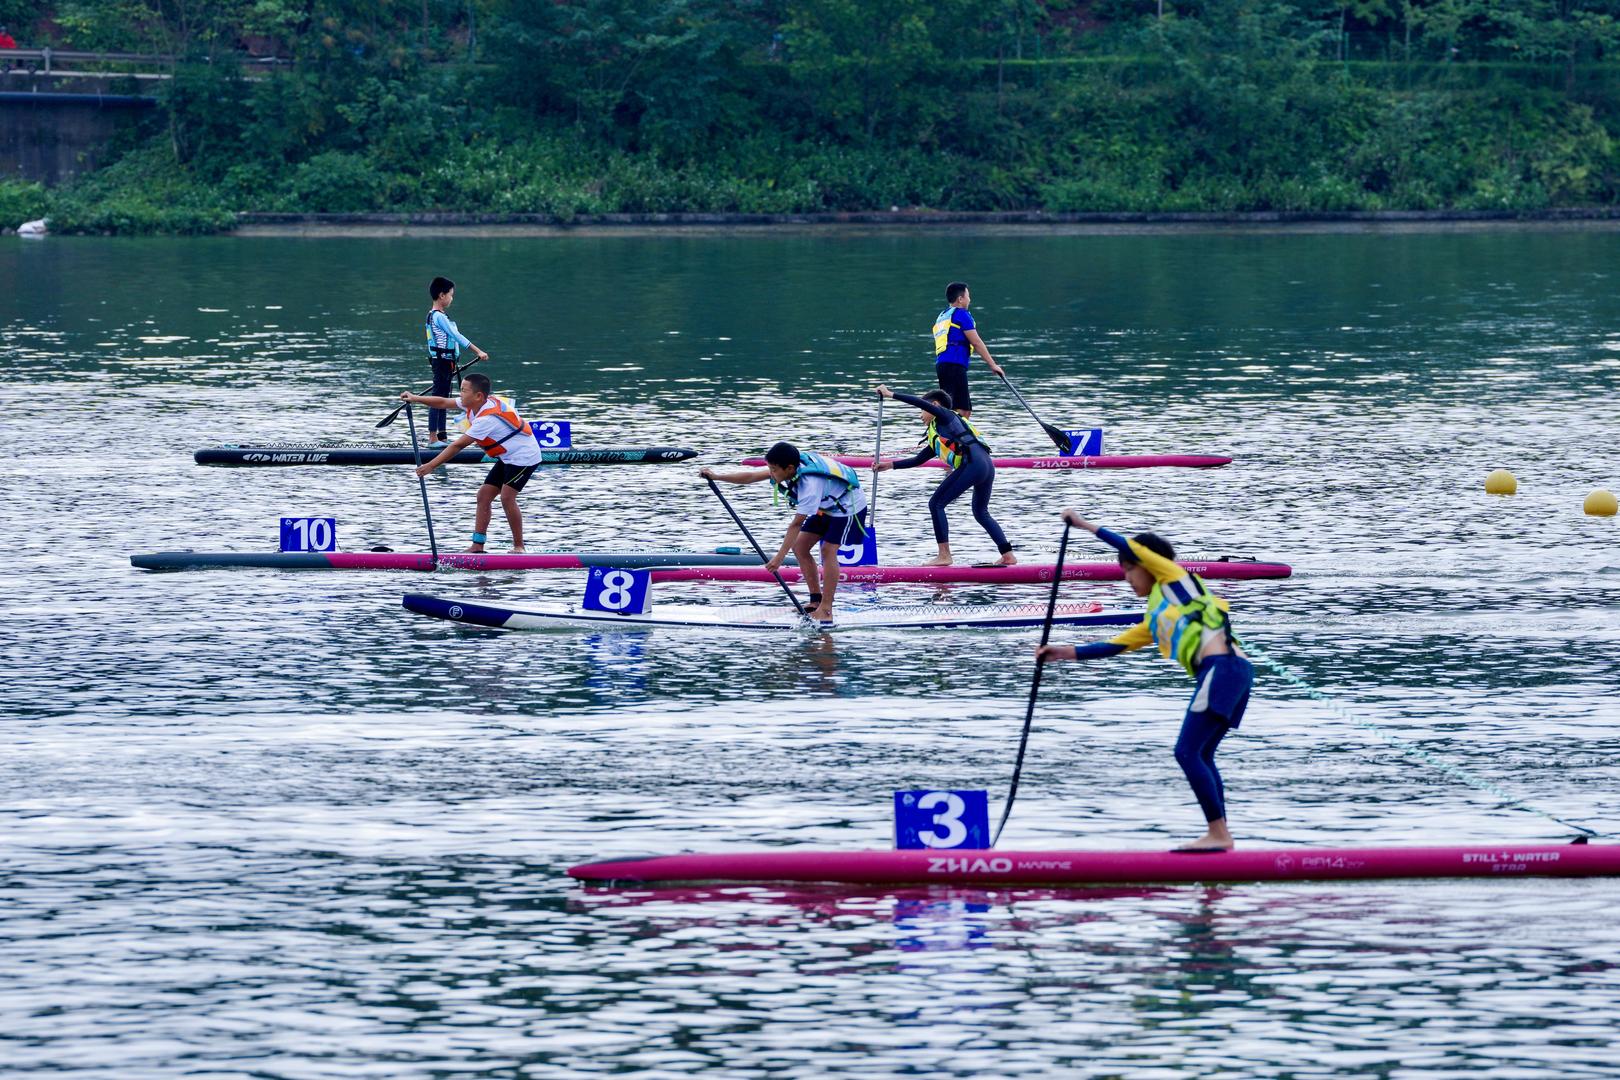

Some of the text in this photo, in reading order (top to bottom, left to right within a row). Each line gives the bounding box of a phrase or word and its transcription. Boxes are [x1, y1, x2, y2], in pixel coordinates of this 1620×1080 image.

[539, 422, 561, 447] 3
[1072, 430, 1092, 456] 7
[271, 453, 329, 462] WATER LIVE
[1032, 460, 1070, 468] ZHAO
[293, 518, 331, 551] 10
[598, 570, 635, 610] 8
[917, 791, 967, 848] 3
[927, 857, 1072, 873] ZHAO MARINE
[1463, 852, 1560, 863] STILL WATER
